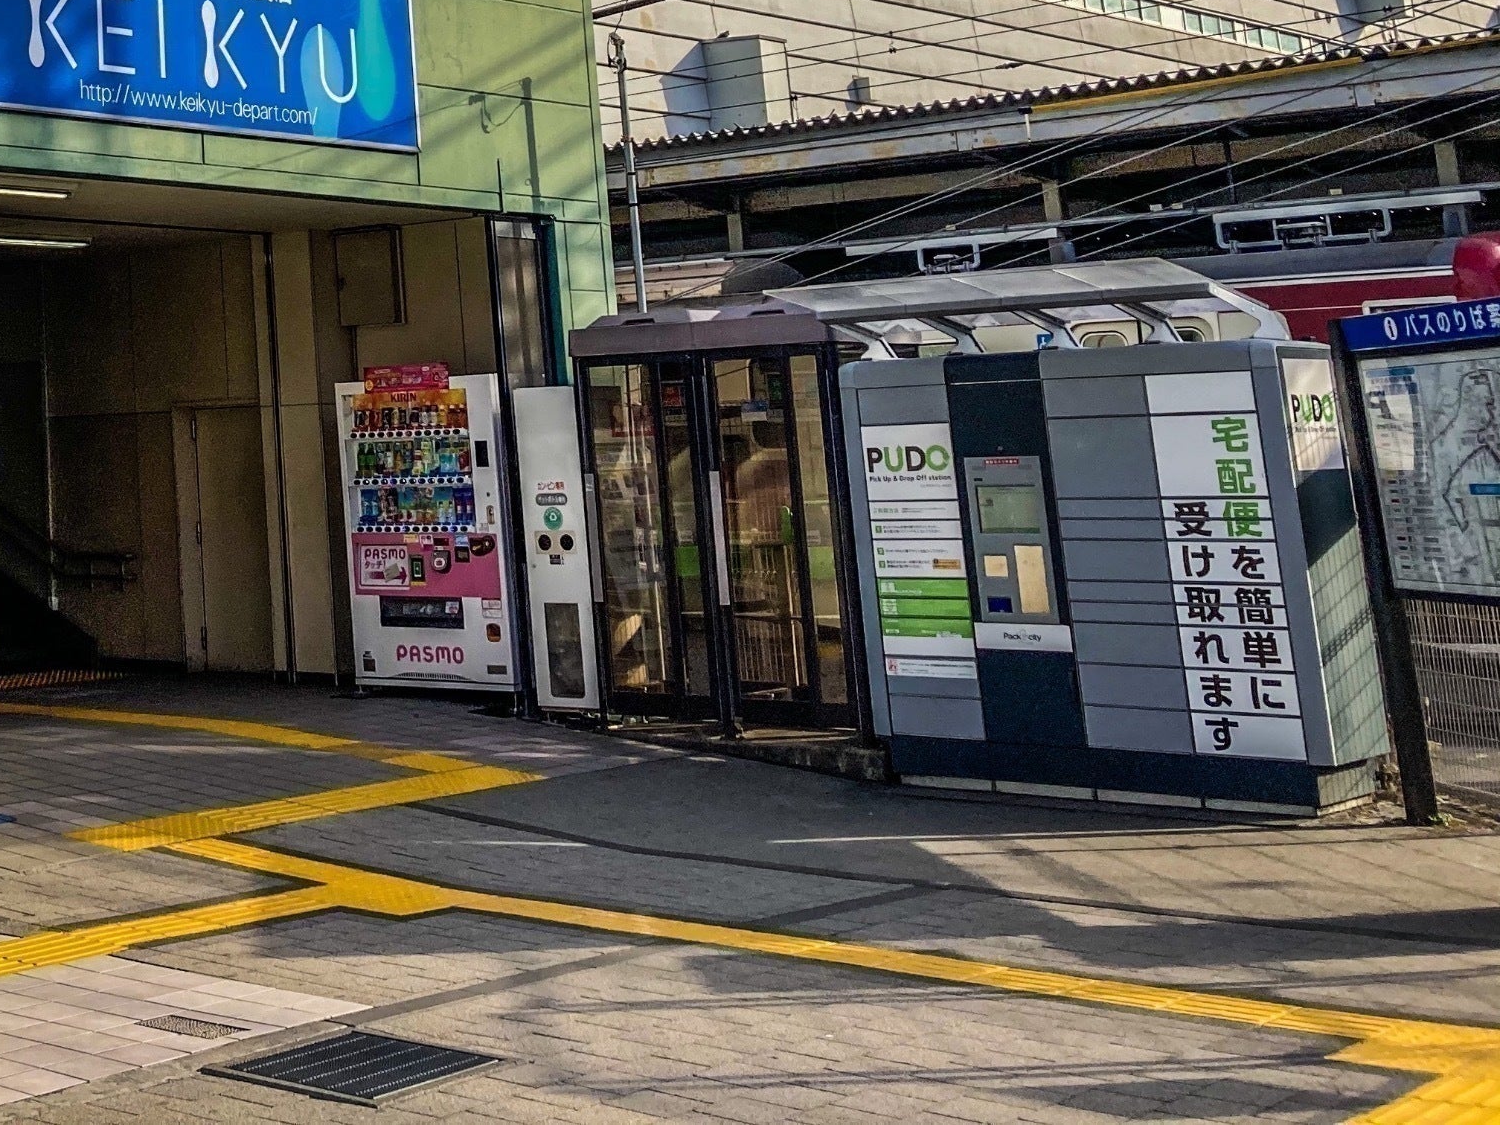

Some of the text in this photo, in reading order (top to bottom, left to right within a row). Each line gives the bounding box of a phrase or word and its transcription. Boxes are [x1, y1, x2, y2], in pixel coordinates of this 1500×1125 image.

[79, 78, 318, 126] http://www.keikyu-depart.com/
[390, 391, 417, 403] KIRIN
[1290, 394, 1334, 423] PUDO
[866, 444, 950, 473] PUDO
[883, 475, 892, 484] Up
[364, 548, 407, 560] PASMO
[1211, 416, 1287, 710] 宅配便を簡単に
[1173, 501, 1241, 752] 受け取れます
[396, 644, 465, 665] PASMO
